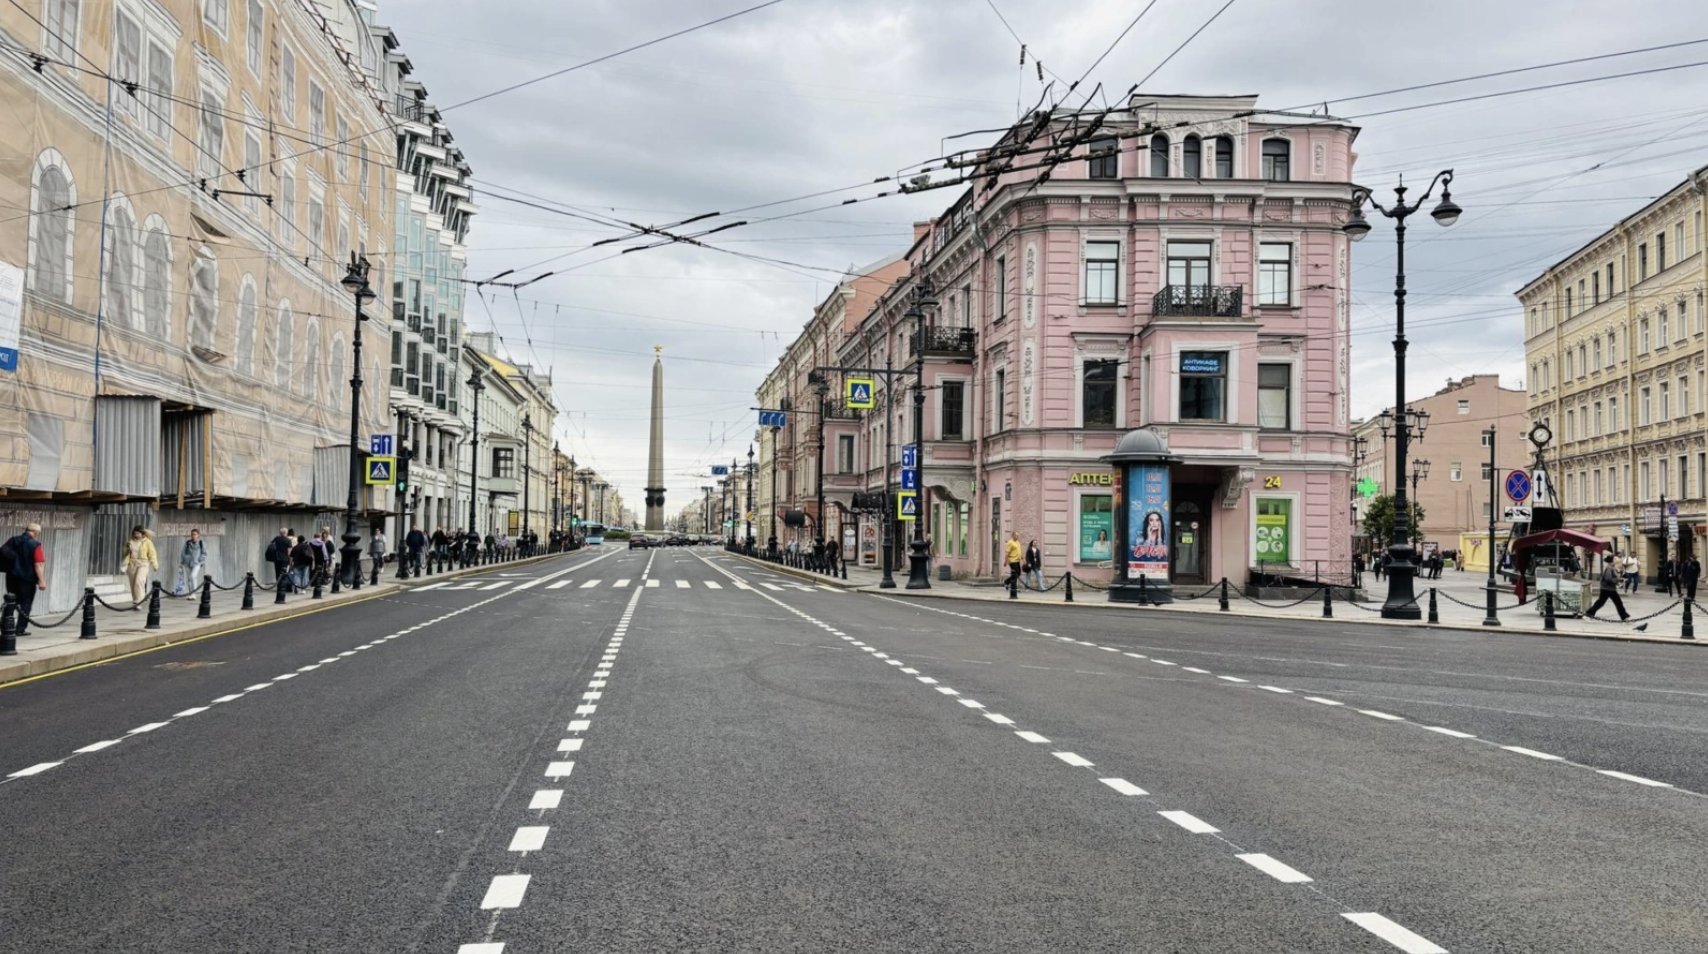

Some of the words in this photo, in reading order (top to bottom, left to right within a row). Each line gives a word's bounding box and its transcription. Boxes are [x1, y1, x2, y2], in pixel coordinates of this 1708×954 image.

[1264, 475, 1281, 488] 24
[15, 510, 50, 529] EUROPEAN
[53, 511, 77, 528] CUISINE
